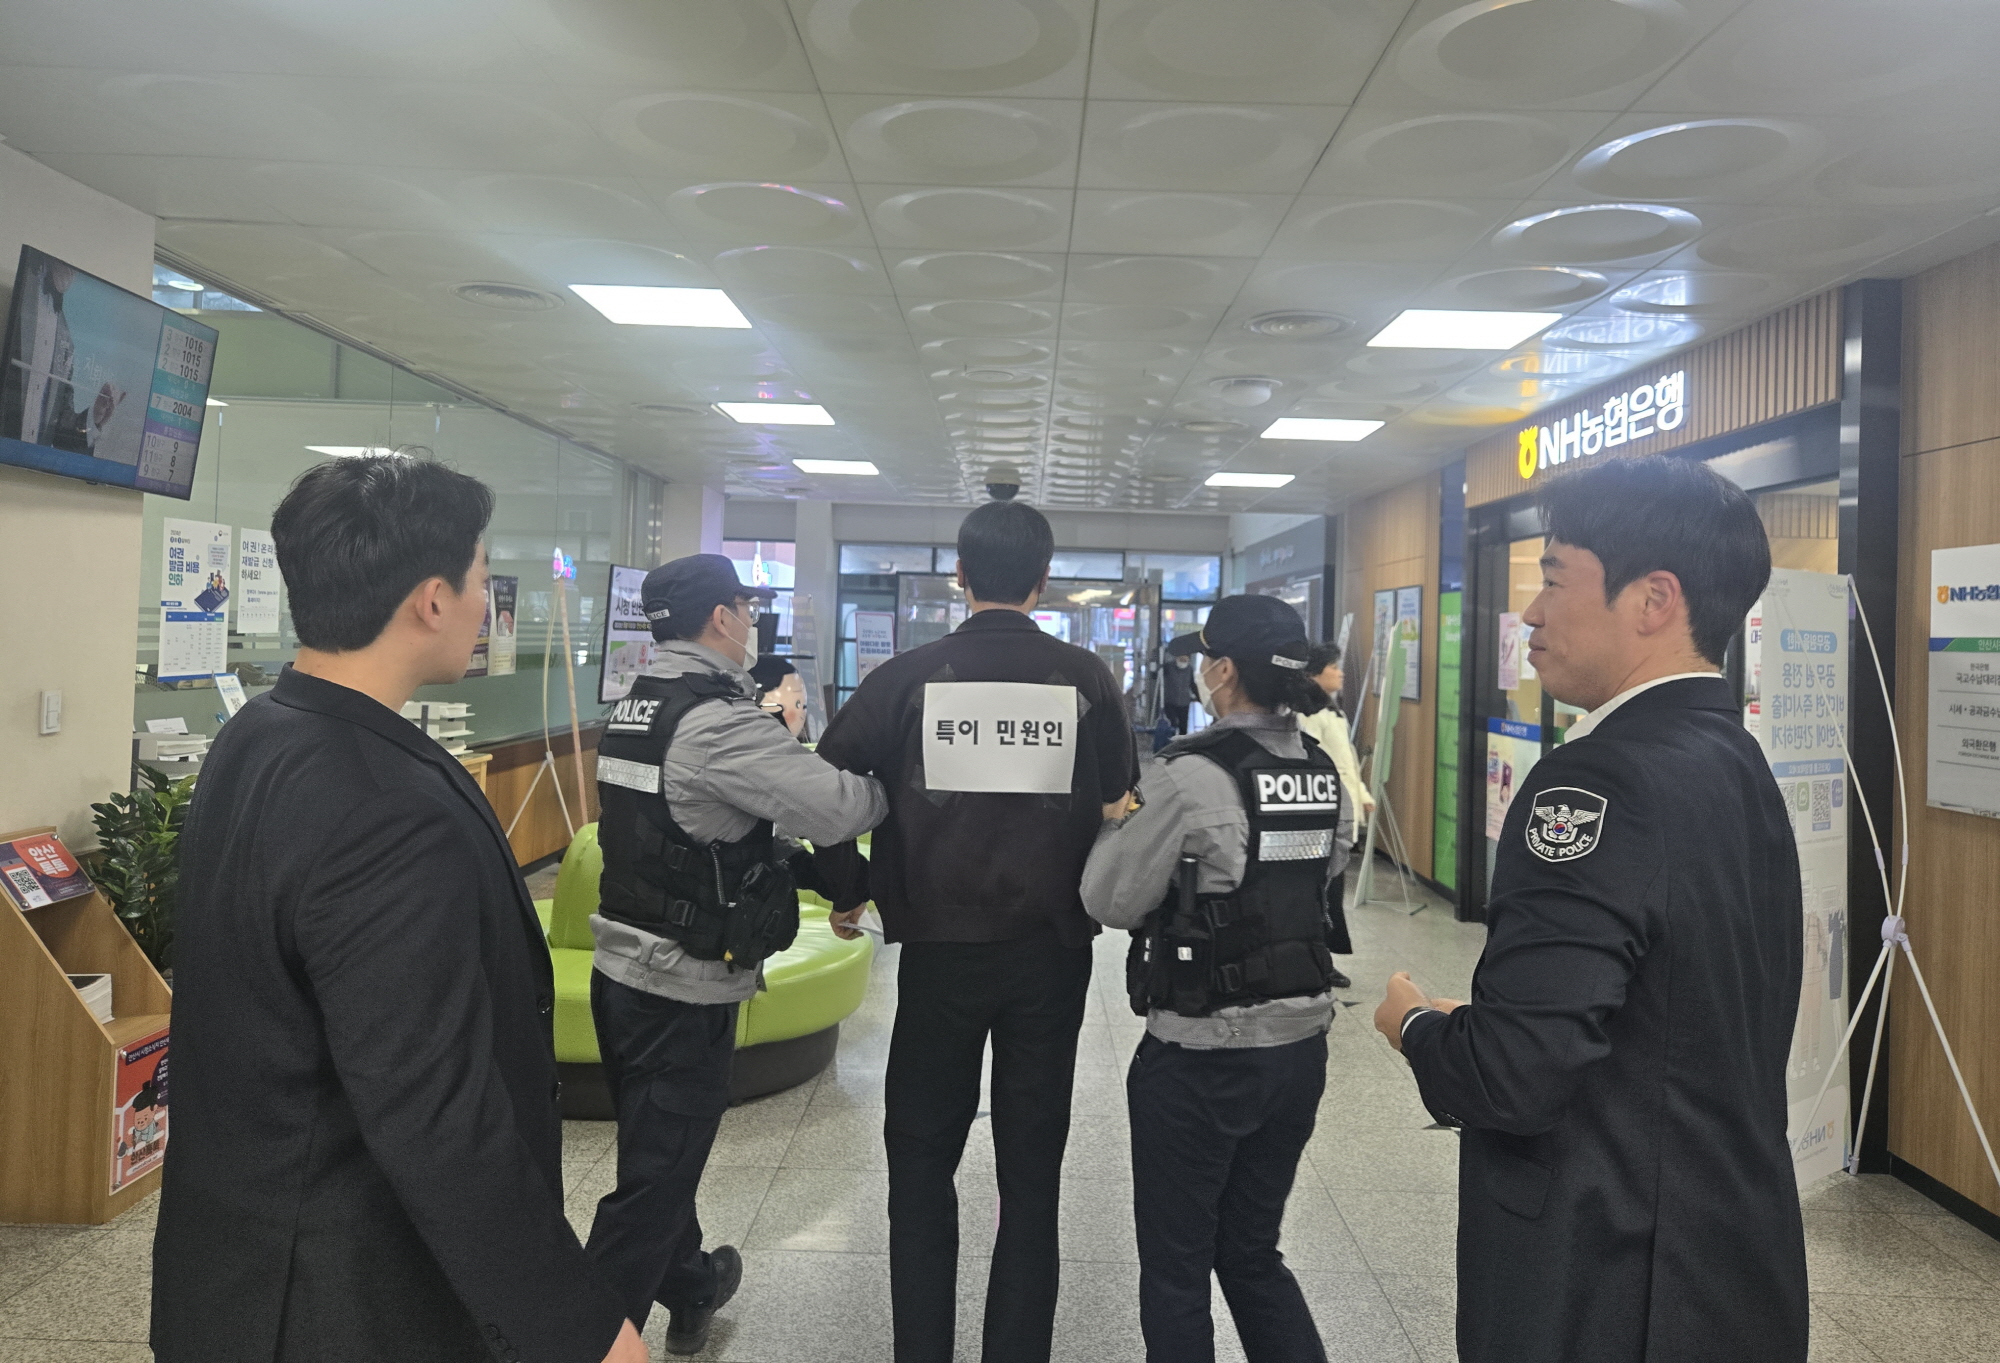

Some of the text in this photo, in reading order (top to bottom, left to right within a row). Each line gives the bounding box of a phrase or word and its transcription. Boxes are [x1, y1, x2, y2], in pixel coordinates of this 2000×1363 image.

[166, 329, 173, 341] 3
[185, 336, 203, 353] 1016
[164, 343, 171, 356] 2
[183, 350, 201, 367] 1015
[161, 357, 168, 369] 2
[180, 364, 199, 381] 1015
[173, 402, 193, 417] 2004
[1538, 370, 1685, 470] NH농협은행
[147, 435, 157, 448] 10
[173, 441, 179, 453] 9
[144, 450, 154, 462] 11
[170, 456, 177, 468] 8
[143, 464, 149, 476] 9
[168, 469, 174, 482] 7
[169, 547, 185, 560] 여권
[261, 543, 277, 555] 온라
[169, 560, 200, 574] 발급 비용
[242, 556, 274, 568] 재발급 신청
[168, 572, 184, 586] 인하
[241, 570, 261, 581] 하세요!
[1978, 638, 2000, 651] 안산시
[610, 699, 660, 724] POLICE
[936, 720, 1063, 747] 특이 민원인
[1961, 738, 1997, 752] 외국환은행
[1257, 774, 1338, 803] POLICE
[1529, 827, 1594, 857] PRIVATE POLICE
[28, 844, 59, 862] 안산
[39, 858, 69, 875] 톡톡
